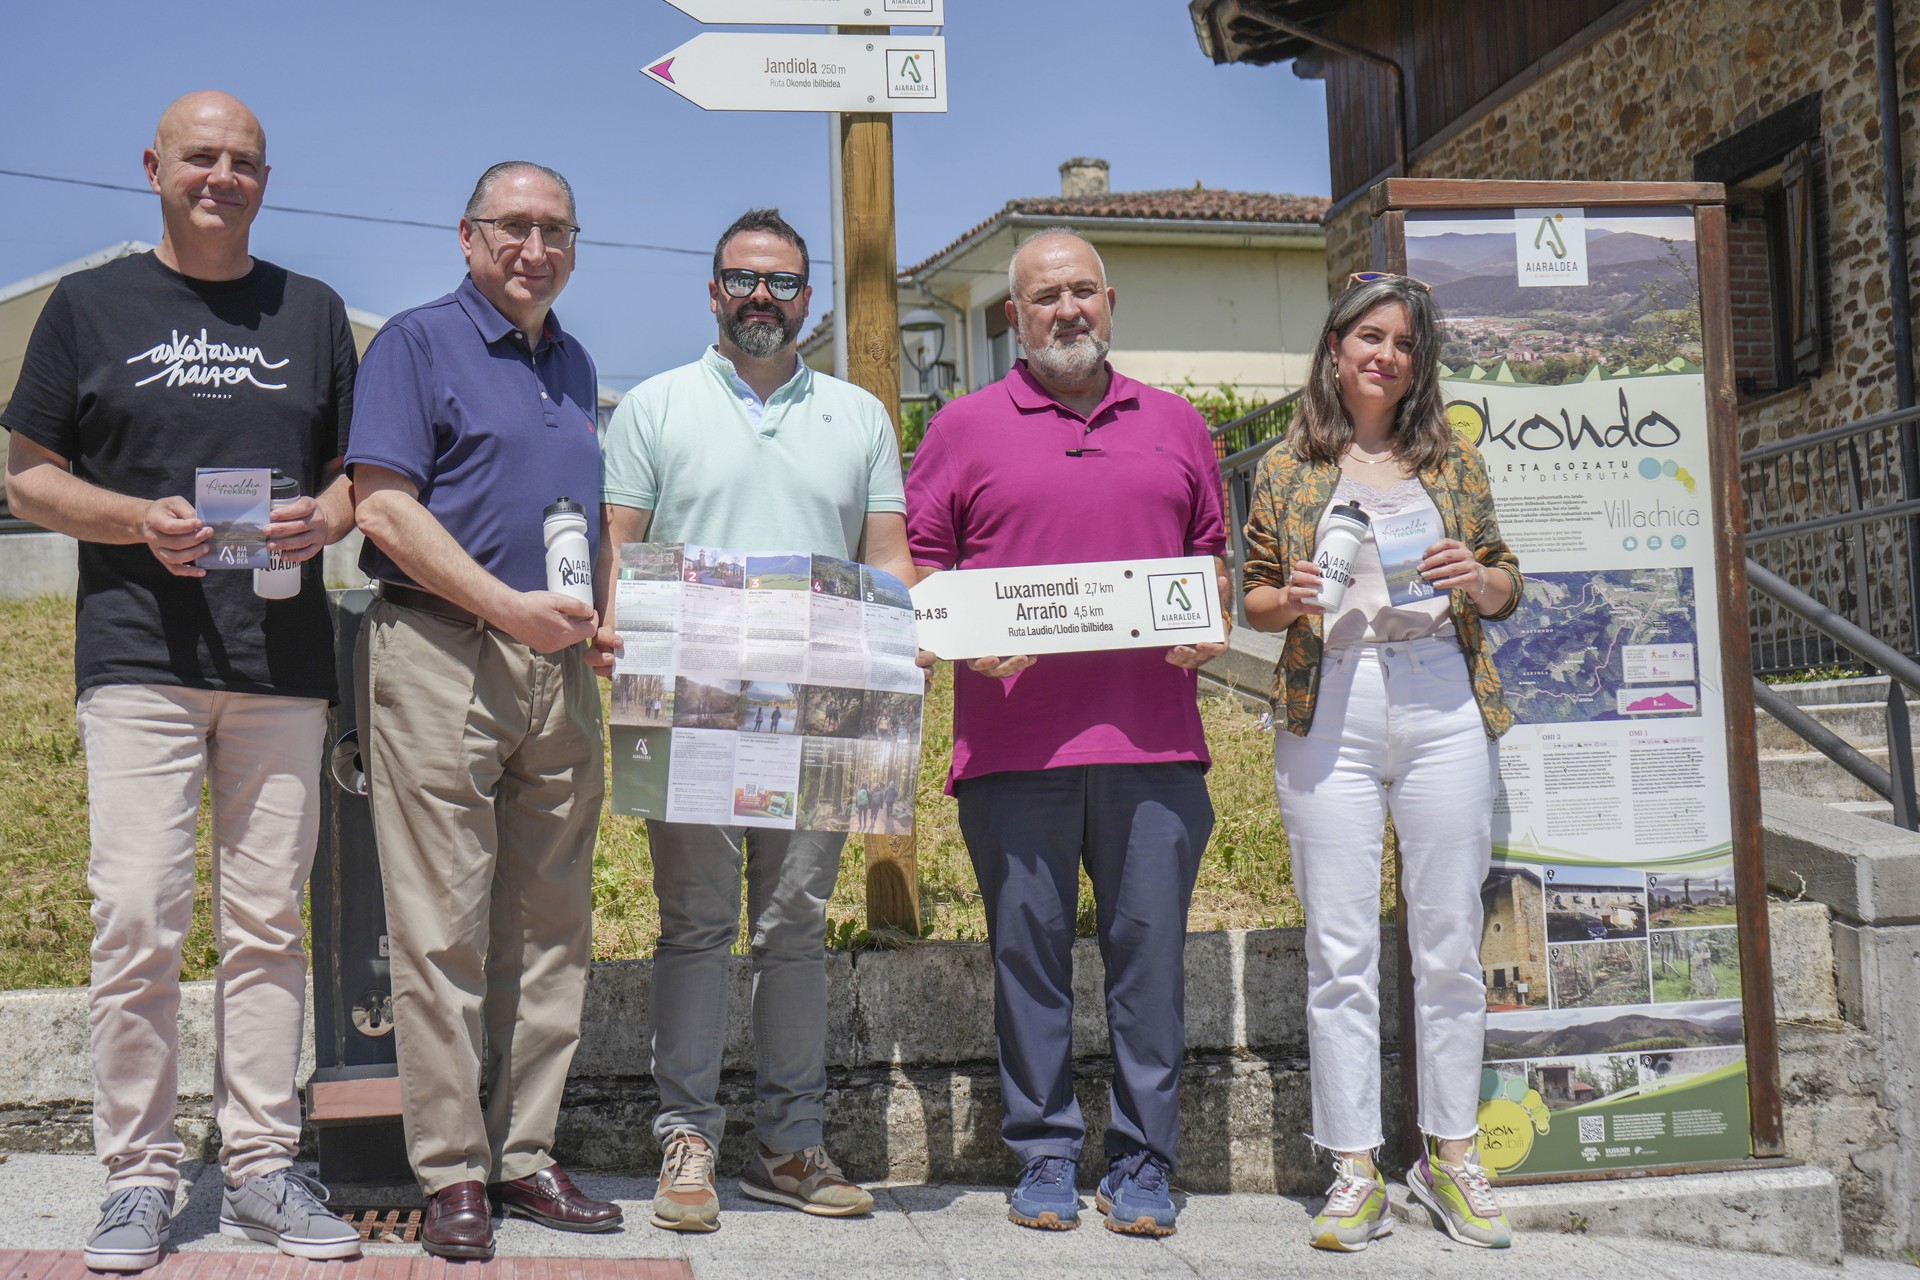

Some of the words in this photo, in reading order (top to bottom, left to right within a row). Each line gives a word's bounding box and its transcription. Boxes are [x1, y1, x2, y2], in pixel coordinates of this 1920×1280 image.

[764, 58, 817, 74] Jandiola
[821, 64, 836, 75] 250
[838, 66, 846, 75] m
[770, 79, 785, 87] Ruta
[786, 79, 811, 88] Okondo
[812, 79, 840, 88] ibilbidea
[1526, 262, 1578, 272] AIARALDEA
[1507, 464, 1540, 472] ETA
[1554, 460, 1628, 470] GOZATU
[1540, 472, 1629, 483] DISFRUTA
[218, 488, 257, 496] Trekking
[1603, 498, 1700, 529] Villachica
[626, 569, 632, 580] 1
[688, 571, 697, 582] 2
[751, 579, 759, 588] 3
[814, 581, 821, 592] 4
[995, 577, 1080, 600] Luxamendi
[1084, 583, 1097, 596] 2,7
[1100, 582, 1114, 593] km
[867, 592, 874, 602] 5
[935, 608, 947, 619] 35
[1016, 602, 1067, 621] Arraño
[1074, 606, 1087, 619] 4,5
[1090, 605, 1104, 617] km
[1161, 612, 1201, 622] AIARALDEA
[1008, 627, 1026, 637] Ruta
[1027, 624, 1080, 636] Laudio/Llodio
[1081, 622, 1114, 633] ibilbidea
